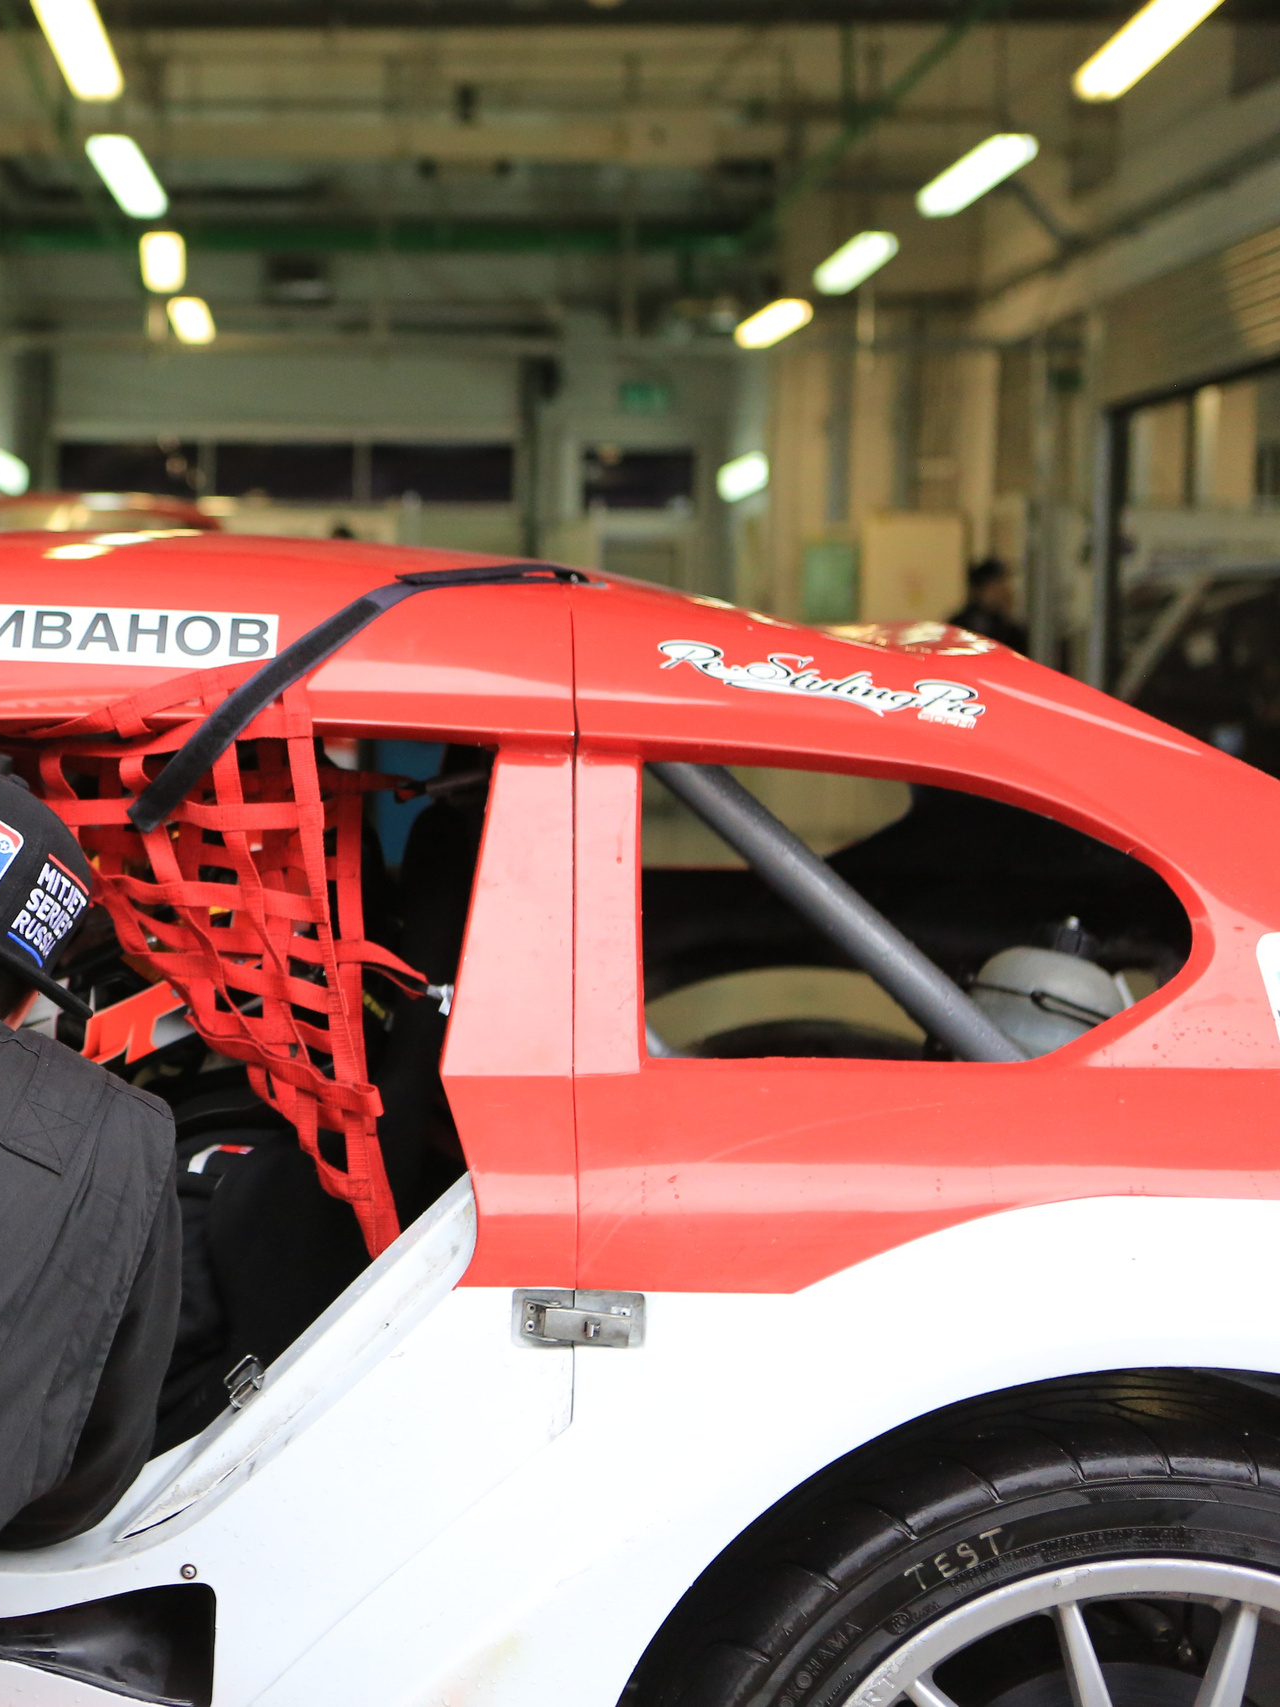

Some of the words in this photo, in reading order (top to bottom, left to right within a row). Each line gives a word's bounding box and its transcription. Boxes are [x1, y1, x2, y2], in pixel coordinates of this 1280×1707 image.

[25, 888, 73, 940] SERIES
[36, 862, 88, 919] MITJET
[903, 1526, 1004, 1591] TEST
[778, 1621, 863, 1707] OKOHAMA
